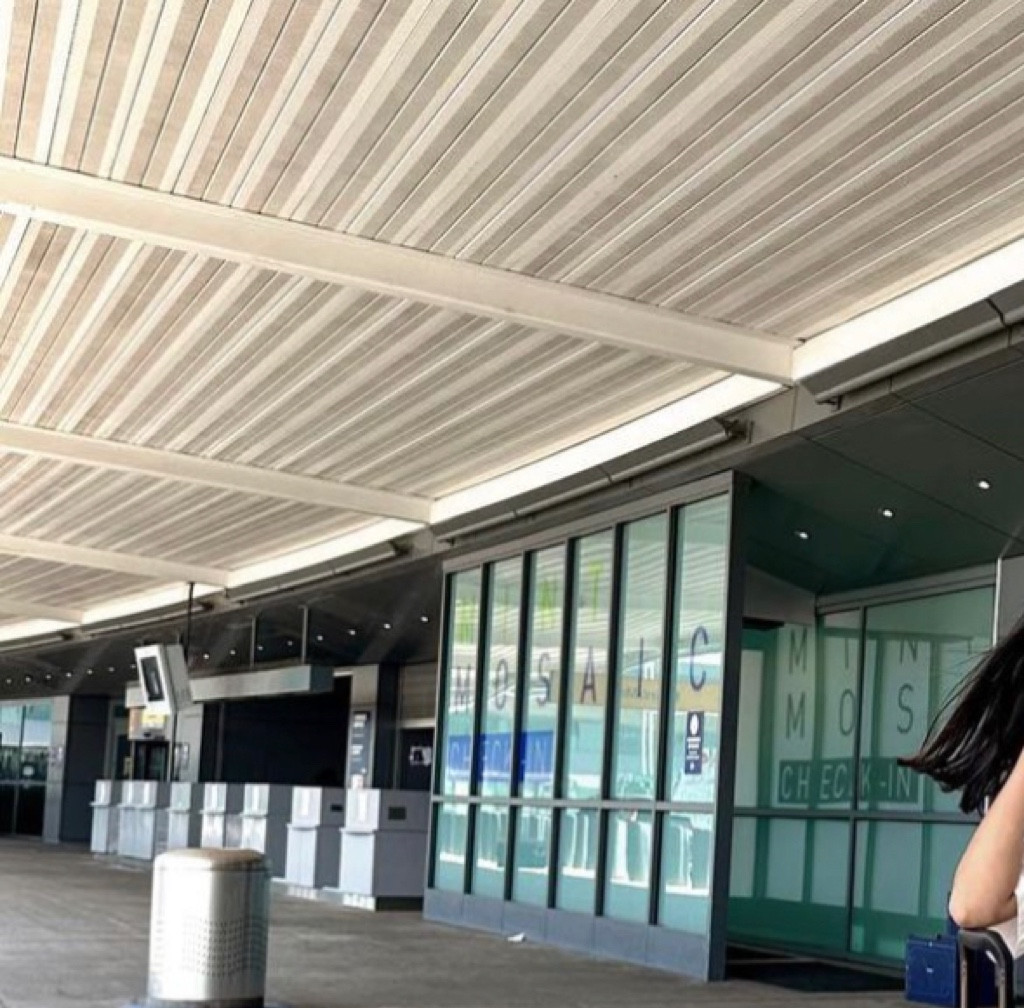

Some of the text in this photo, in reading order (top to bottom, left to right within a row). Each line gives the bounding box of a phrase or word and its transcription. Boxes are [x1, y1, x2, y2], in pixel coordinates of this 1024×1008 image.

[455, 626, 710, 714] MOSAIC
[784, 682, 914, 740] MOS
[780, 762, 911, 799] CHECK-IN
